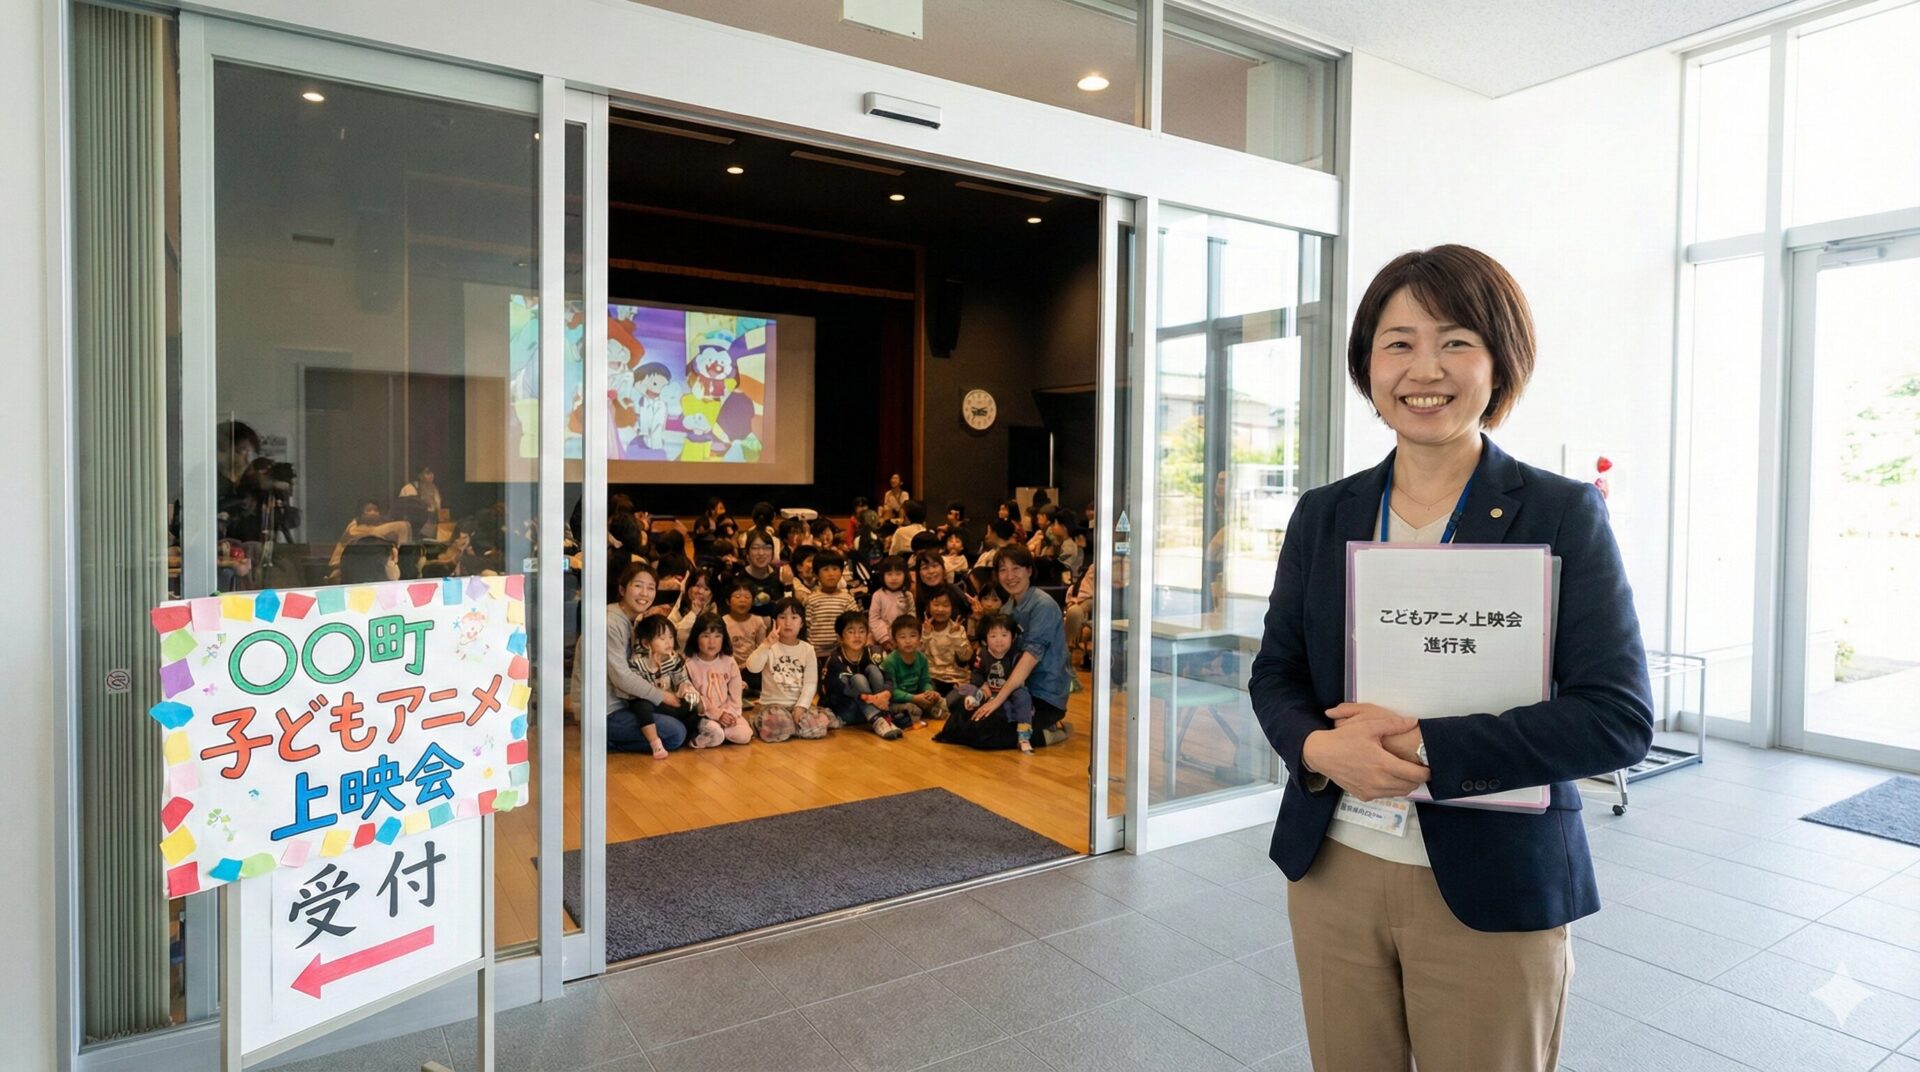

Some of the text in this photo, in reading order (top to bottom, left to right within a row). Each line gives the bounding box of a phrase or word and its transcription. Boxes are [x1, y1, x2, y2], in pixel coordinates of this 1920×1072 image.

[1379, 609, 1523, 628] こどもアニメ上映会
[1423, 636, 1477, 654] 進行表
[200, 674, 504, 779] 子どもアニメ
[270, 742, 464, 842] 上映会
[288, 841, 447, 950] 受付
